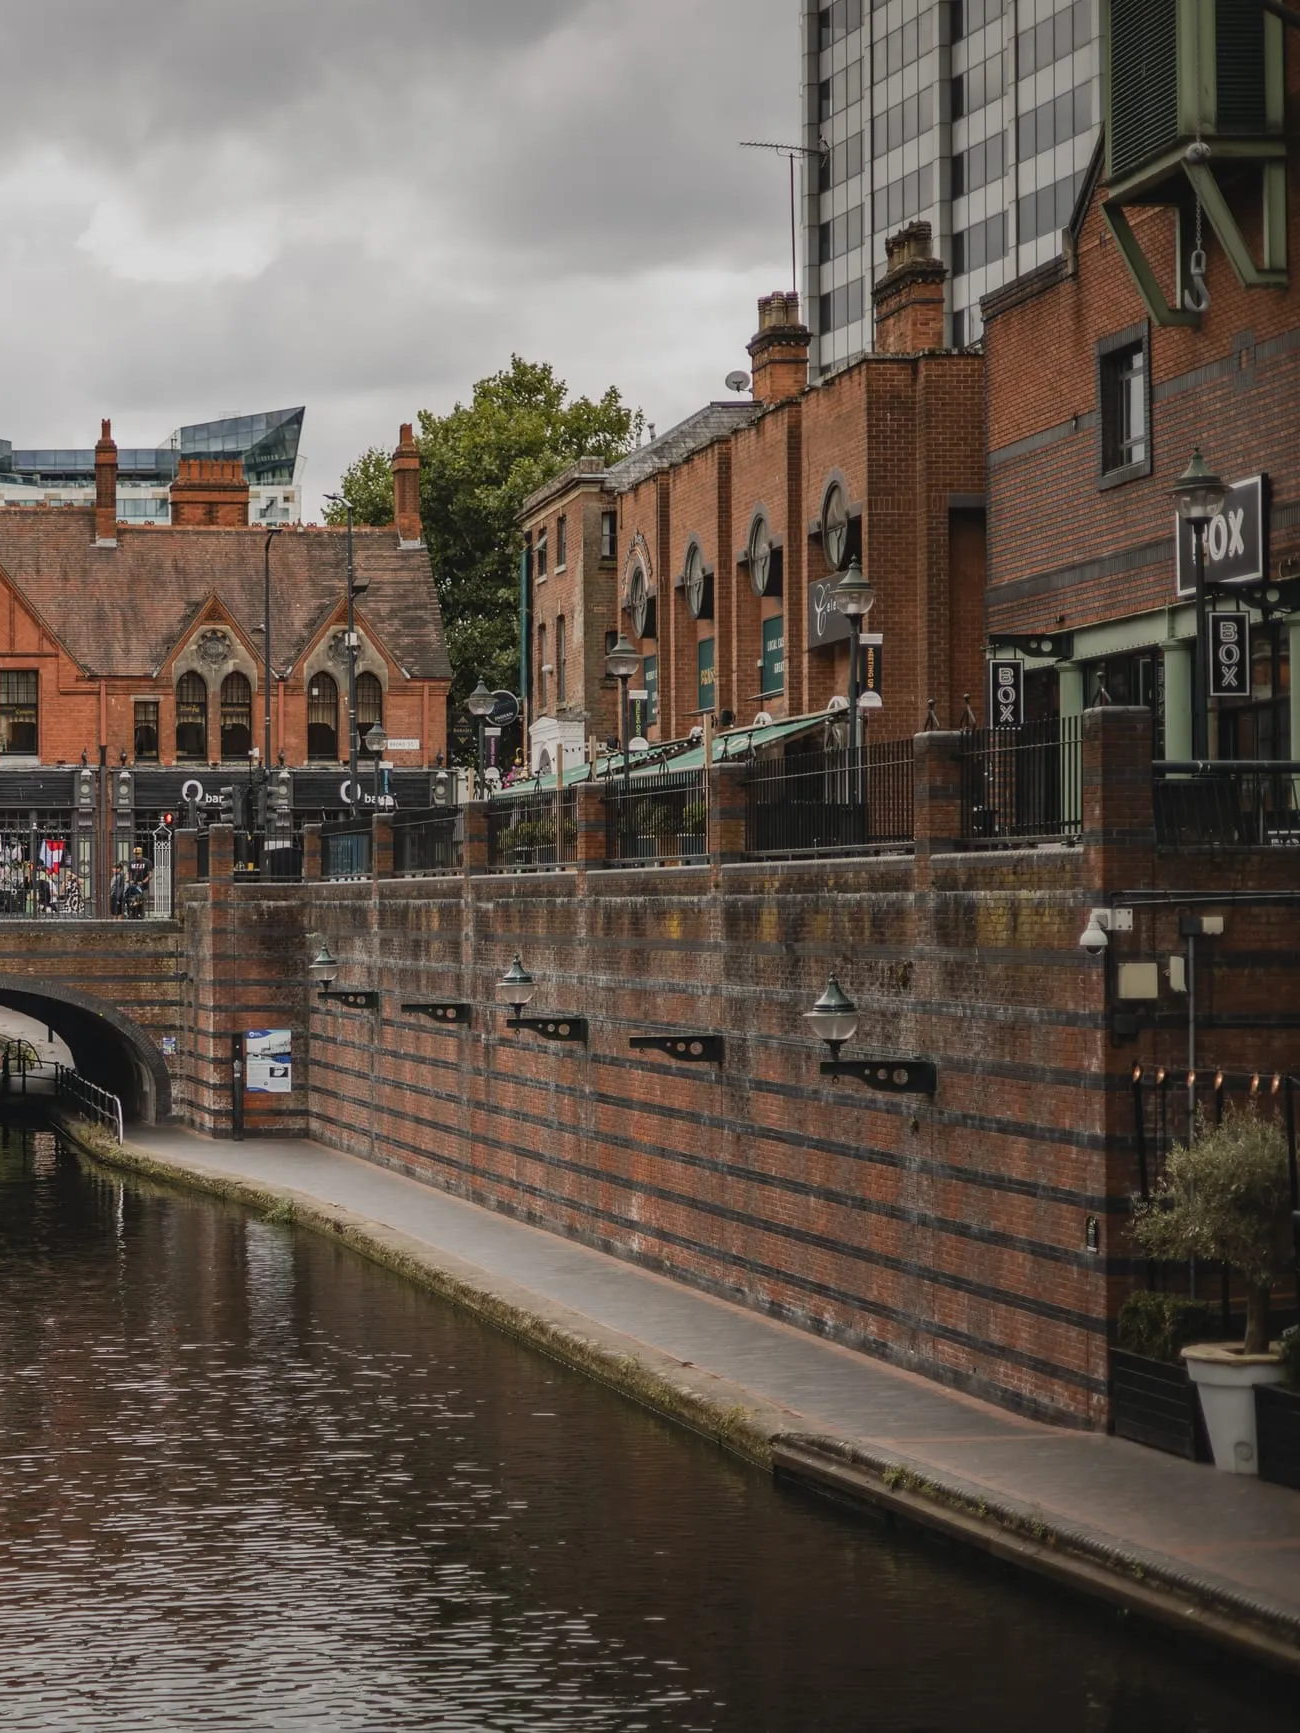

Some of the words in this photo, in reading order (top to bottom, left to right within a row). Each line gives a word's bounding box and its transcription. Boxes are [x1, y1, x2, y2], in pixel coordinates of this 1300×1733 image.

[1218, 621, 1241, 687] BOX
[867, 679, 874, 689] UP
[997, 667, 1016, 723] BOX
[182, 780, 203, 803] O
[205, 793, 225, 803] bar
[340, 780, 361, 804] O
